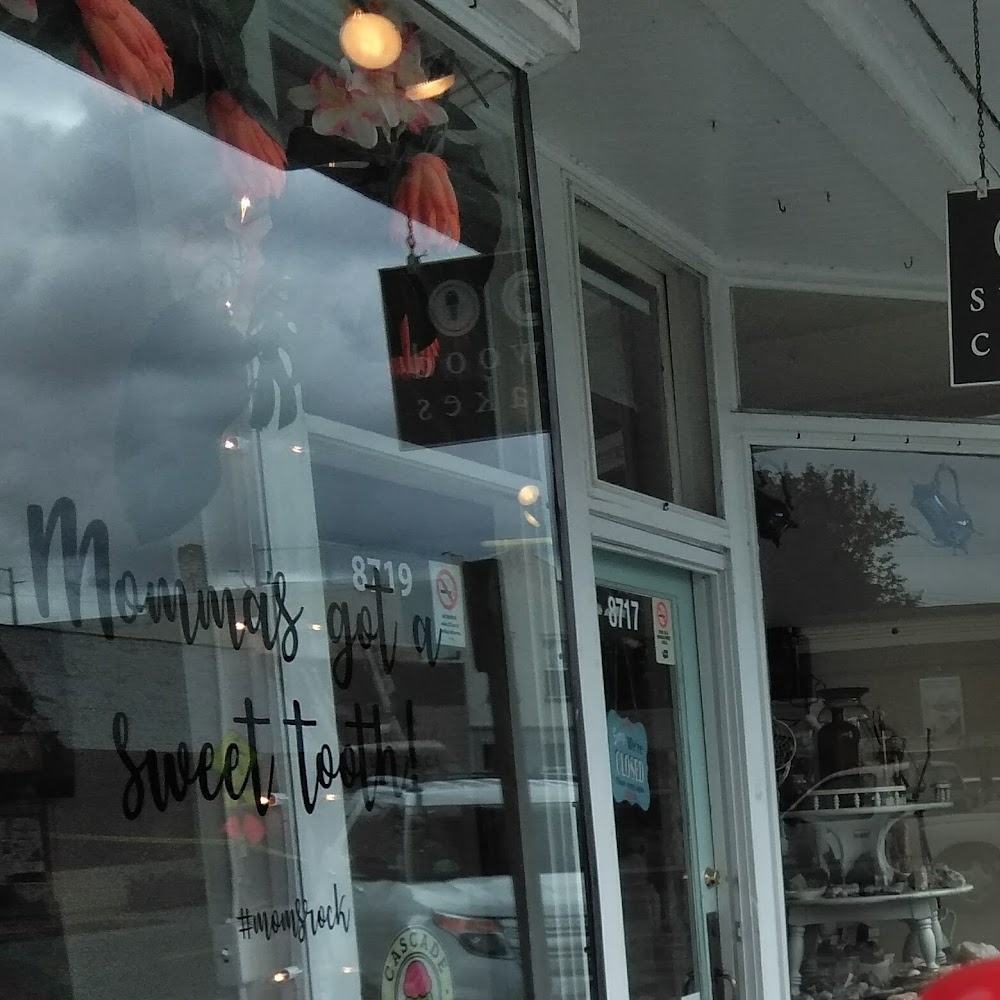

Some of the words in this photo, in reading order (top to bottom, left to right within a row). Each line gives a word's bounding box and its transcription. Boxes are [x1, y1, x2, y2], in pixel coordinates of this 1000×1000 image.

[352, 555, 412, 597] 8719
[327, 567, 398, 689] got
[412, 614, 442, 667] a
[608, 596, 639, 631] 8717
[283, 700, 418, 814] tooth!
[616, 751, 645, 783] CLOSED
[385, 932, 447, 981] CASCADE
